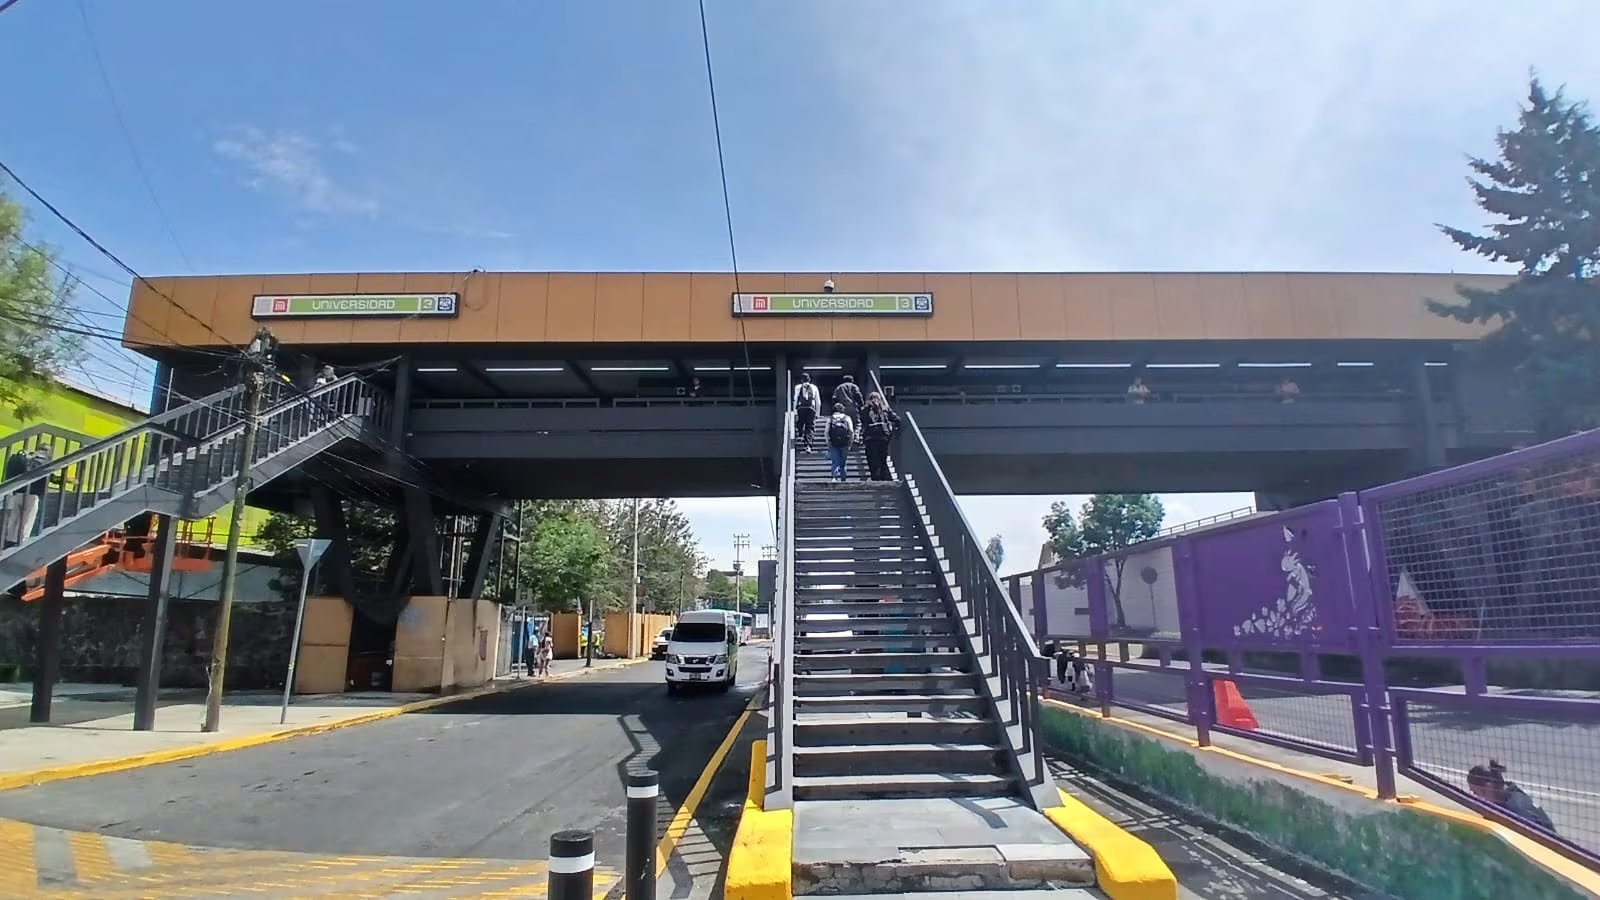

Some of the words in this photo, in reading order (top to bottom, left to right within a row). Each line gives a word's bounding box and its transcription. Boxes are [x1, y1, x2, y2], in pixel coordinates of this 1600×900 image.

[311, 299, 396, 310] UNIVERSIDAD
[423, 299, 433, 310] 3
[792, 298, 874, 309] UNIVERSIDAD
[901, 298, 910, 309] 3
